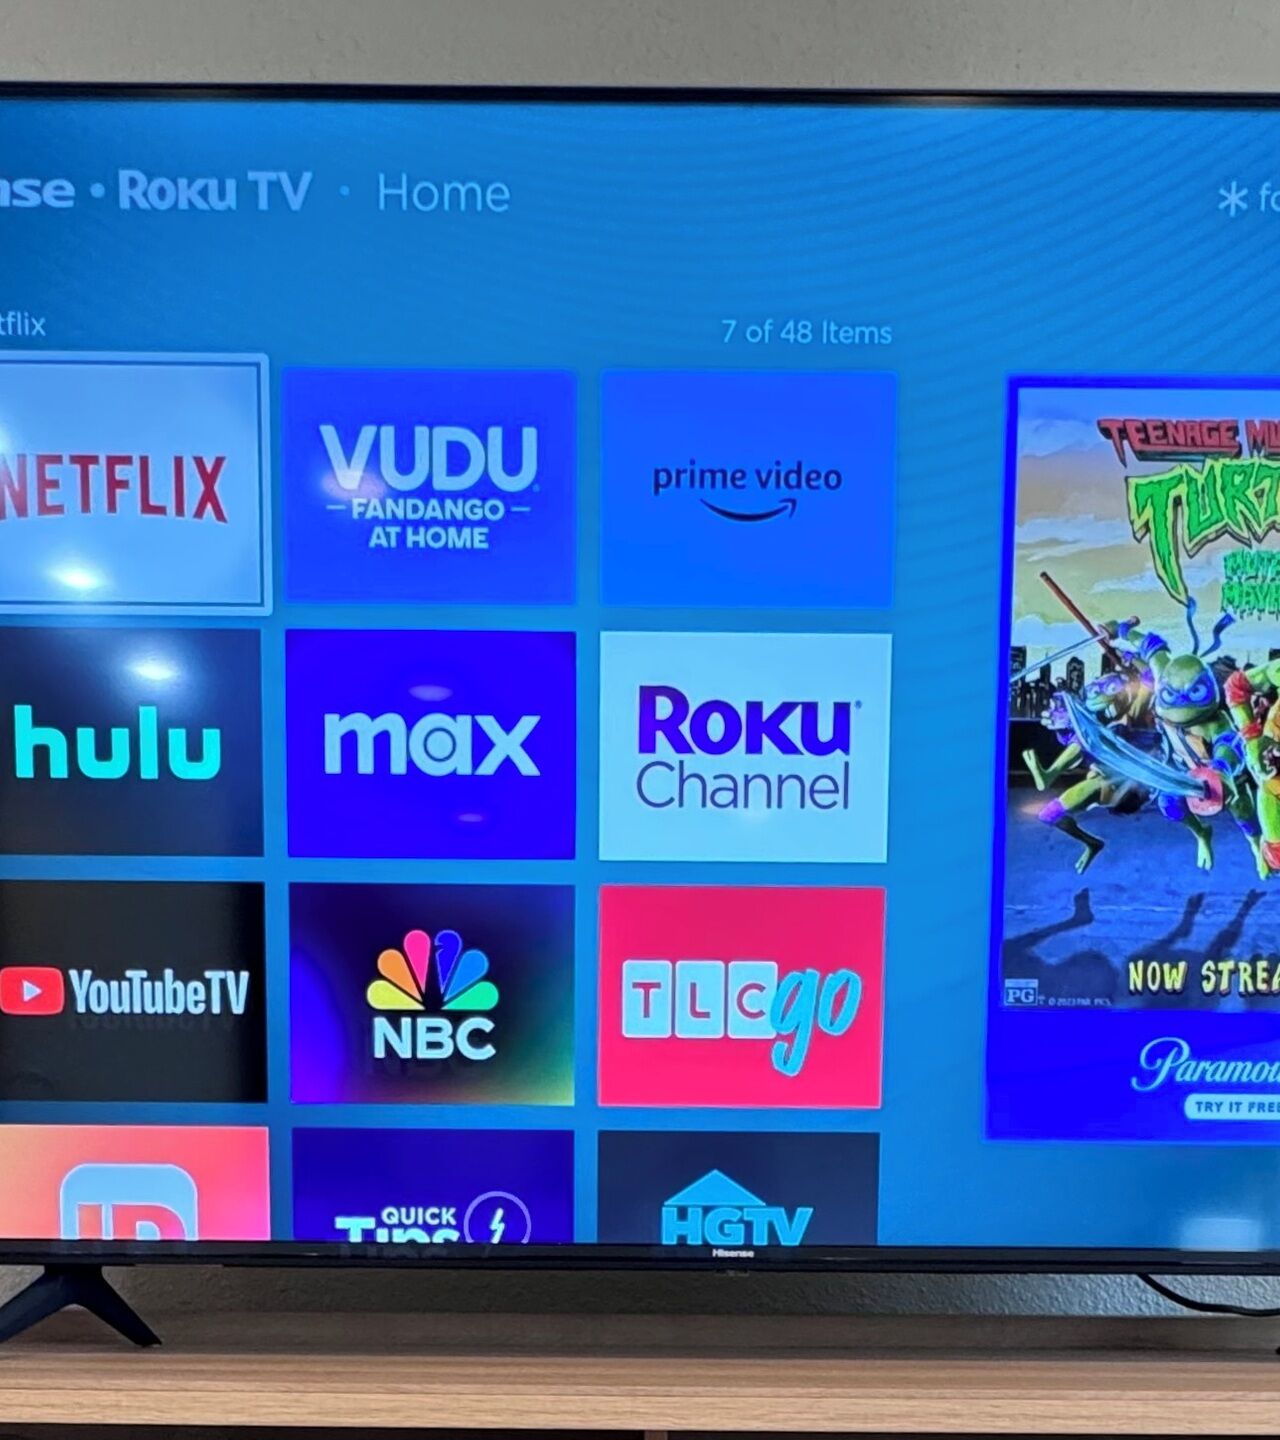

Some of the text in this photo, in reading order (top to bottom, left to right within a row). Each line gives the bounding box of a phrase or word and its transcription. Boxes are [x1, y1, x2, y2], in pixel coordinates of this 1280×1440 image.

[118, 169, 237, 210] Roku
[247, 171, 312, 211] TV
[378, 173, 511, 212] Home
[722, 319, 892, 344] 7 of 48 Items
[320, 425, 537, 492] VUDU
[1098, 419, 1241, 464] TEENAGE
[653, 458, 842, 496] prime video
[352, 498, 504, 521] FANDANGO
[368, 527, 488, 550] AT HOME
[638, 685, 851, 756] Roku
[14, 704, 221, 780] hulu
[323, 711, 541, 777] max
[636, 760, 849, 810] Channel
[1129, 959, 1187, 993] NOW
[1007, 989, 1035, 1003] PG
[374, 1017, 496, 1060] NBC
[1195, 1101, 1222, 1113] TRY
[1229, 1102, 1242, 1113] IT
[381, 1207, 457, 1225] QUICK
[662, 1207, 813, 1246] HGTV
[712, 1249, 754, 1258] Hisense
